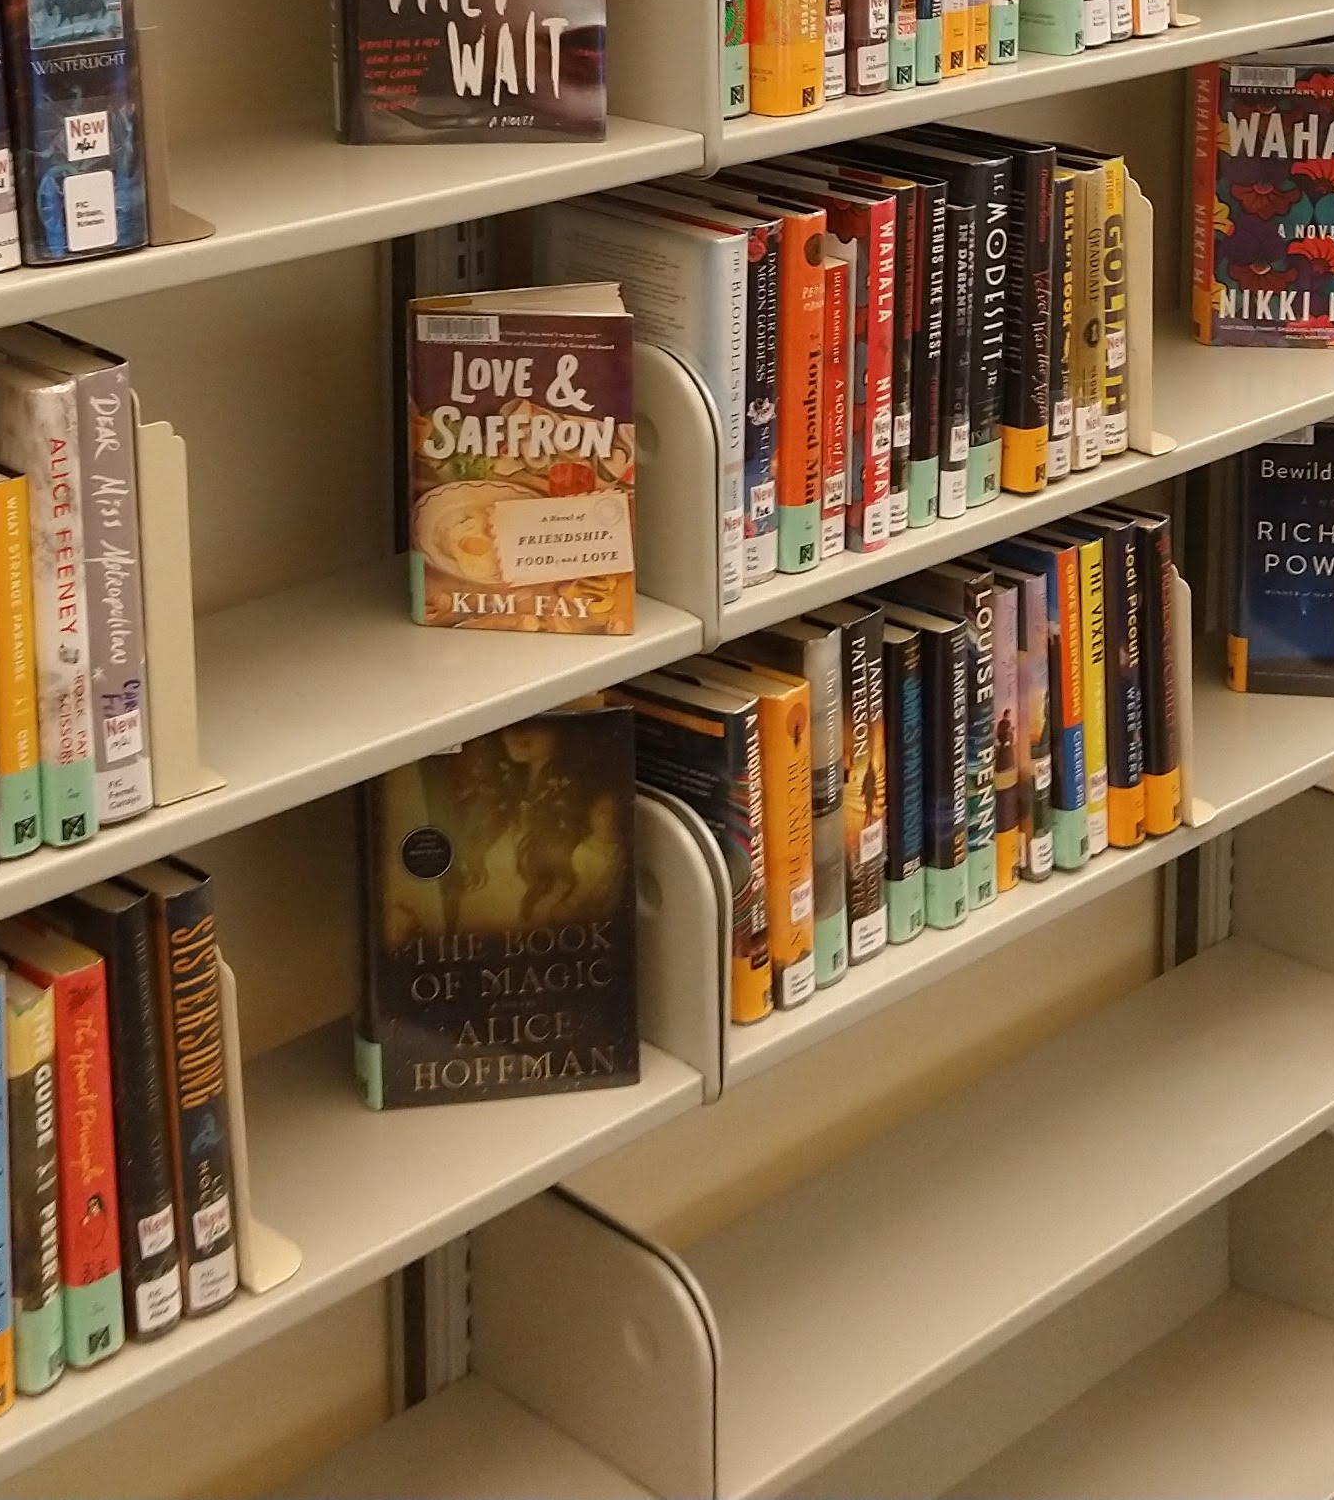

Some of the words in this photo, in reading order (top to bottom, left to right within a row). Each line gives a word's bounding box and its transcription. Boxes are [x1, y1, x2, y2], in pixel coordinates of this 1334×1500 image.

[30, 50, 126, 78] WINTERLIGHT
[447, 11, 569, 107] WAIT
[68, 115, 107, 141] New
[932, 198, 945, 264] FRIENDS
[1278, 223, 1286, 239] A
[877, 221, 894, 323] WAHALA
[930, 271, 943, 305] LIKE
[1219, 289, 1311, 321] NIKKI
[929, 312, 942, 359] THESE
[450, 351, 534, 404] LOVE
[546, 354, 595, 412] &
[425, 405, 615, 460] SAFFRON
[49, 438, 71, 520] ALICE
[55, 528, 79, 636] FEENEY
[1090, 559, 1101, 596] THE
[451, 592, 516, 615] KIM
[535, 595, 595, 619] FAY
[975, 589, 993, 704] LOUISE
[1091, 601, 1104, 665] VIXEN
[977, 746, 994, 851] PENNY
[411, 972, 460, 1000] OF
[480, 959, 612, 997] MAGIC
[413, 1045, 615, 1092] HOFFMAN
